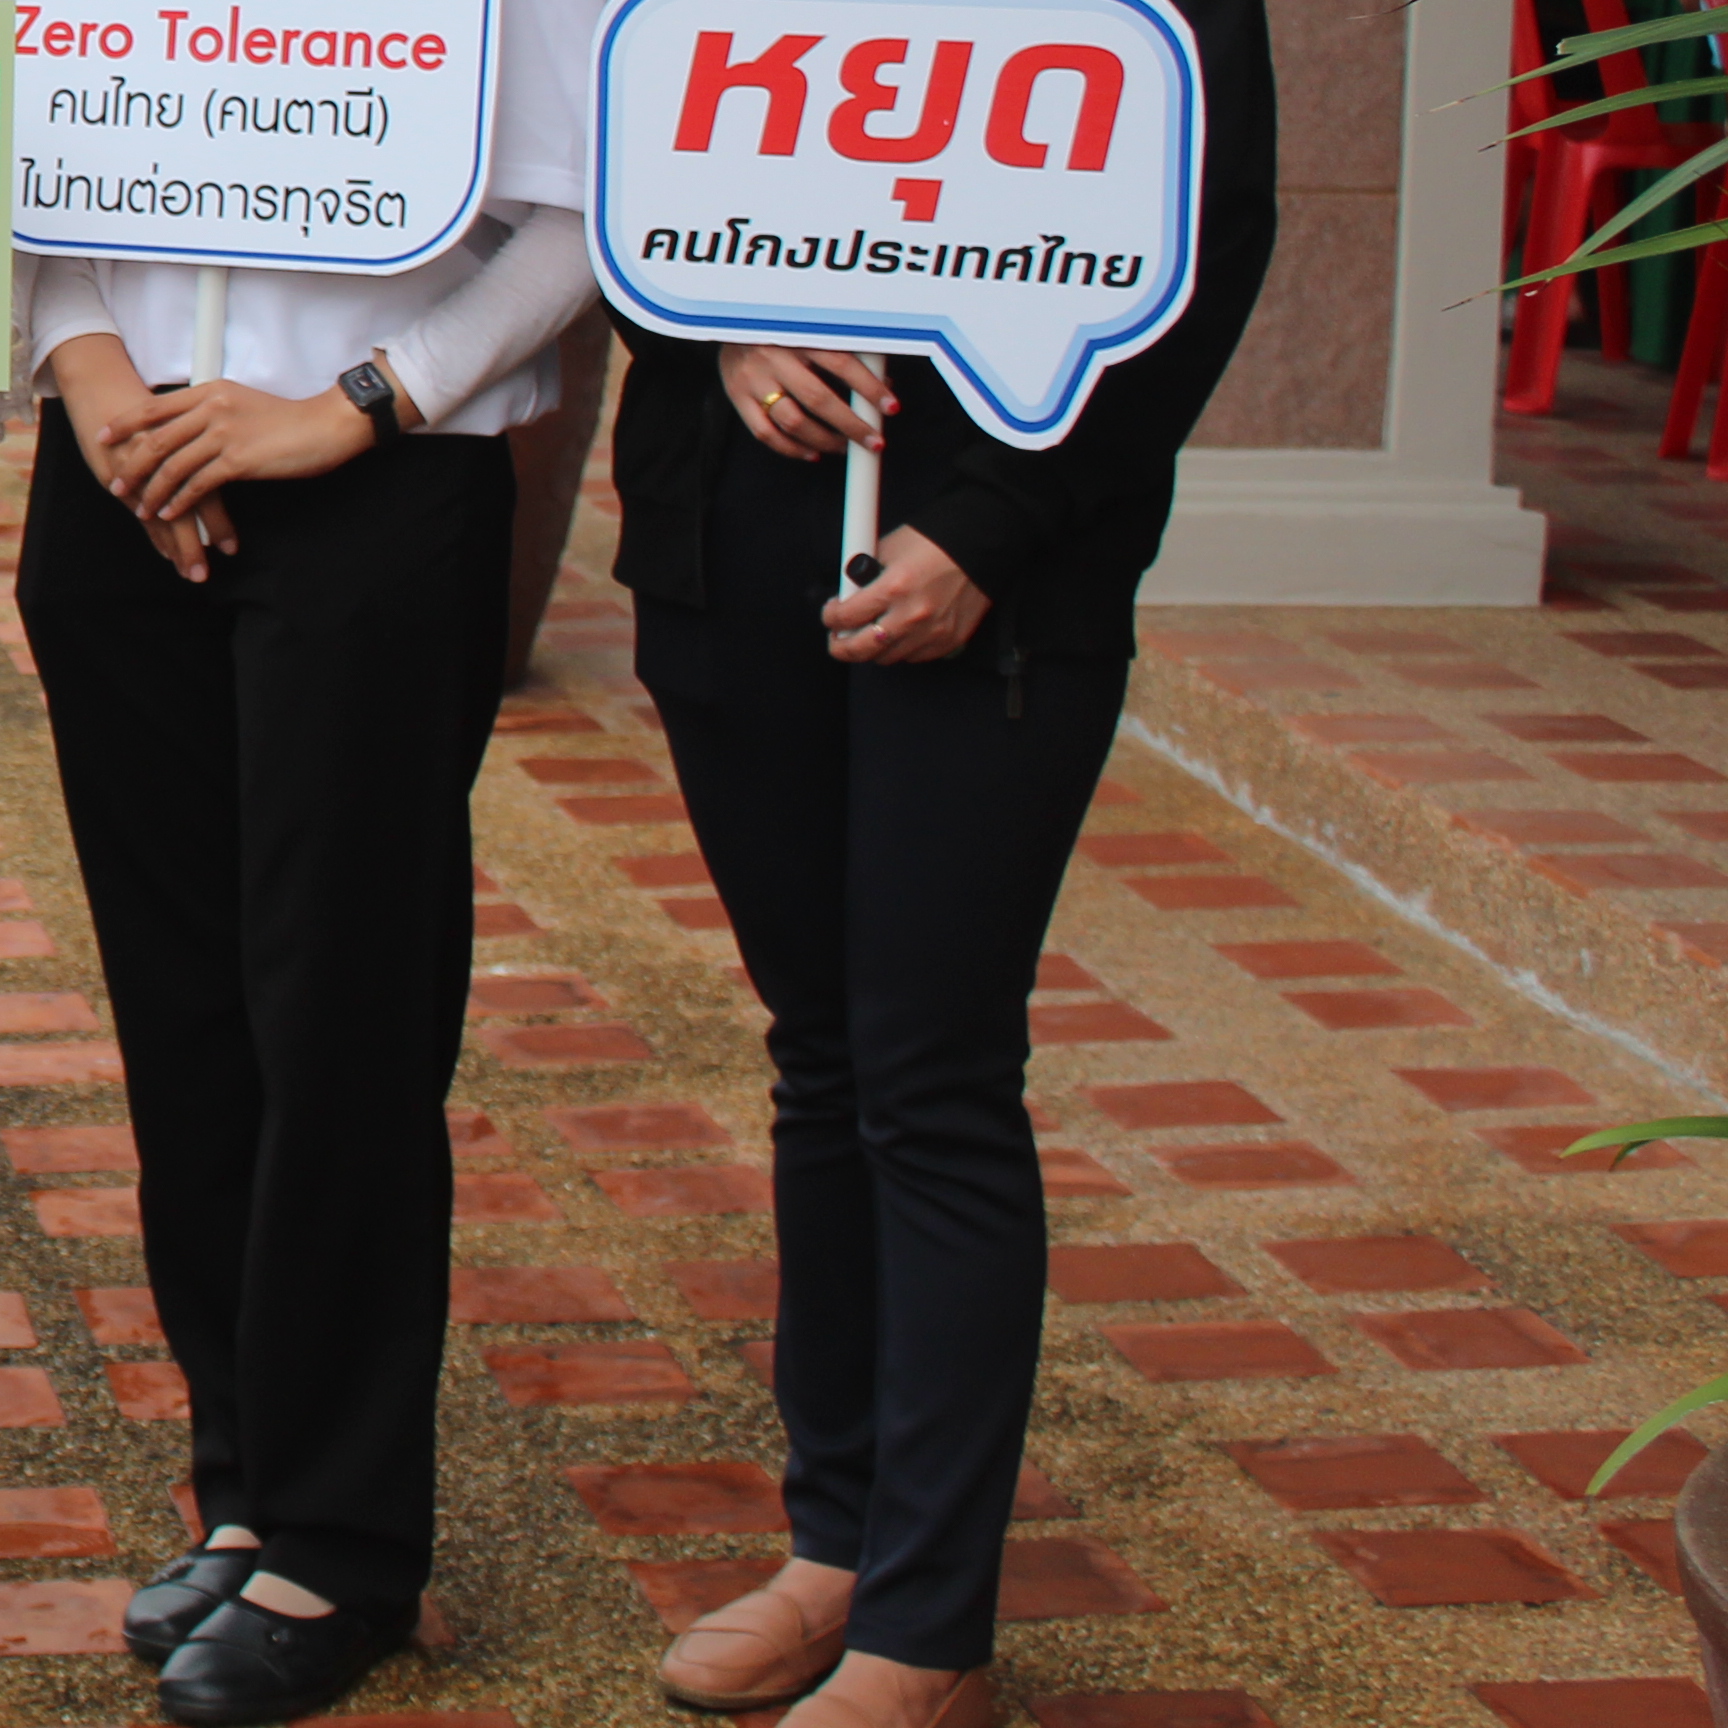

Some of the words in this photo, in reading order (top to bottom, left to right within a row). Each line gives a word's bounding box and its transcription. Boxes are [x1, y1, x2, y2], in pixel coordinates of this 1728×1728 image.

[15, 5, 134, 58] Zero
[158, 6, 447, 71] Tolerance
[48, 77, 184, 129] คนไทย
[203, 86, 389, 147] (คนตานี)
[672, 30, 1124, 223] หยุด
[20, 158, 407, 237] ไม่ทนต่อการทุจริต
[641, 218, 1144, 289] คนโกงประเทศไทย
